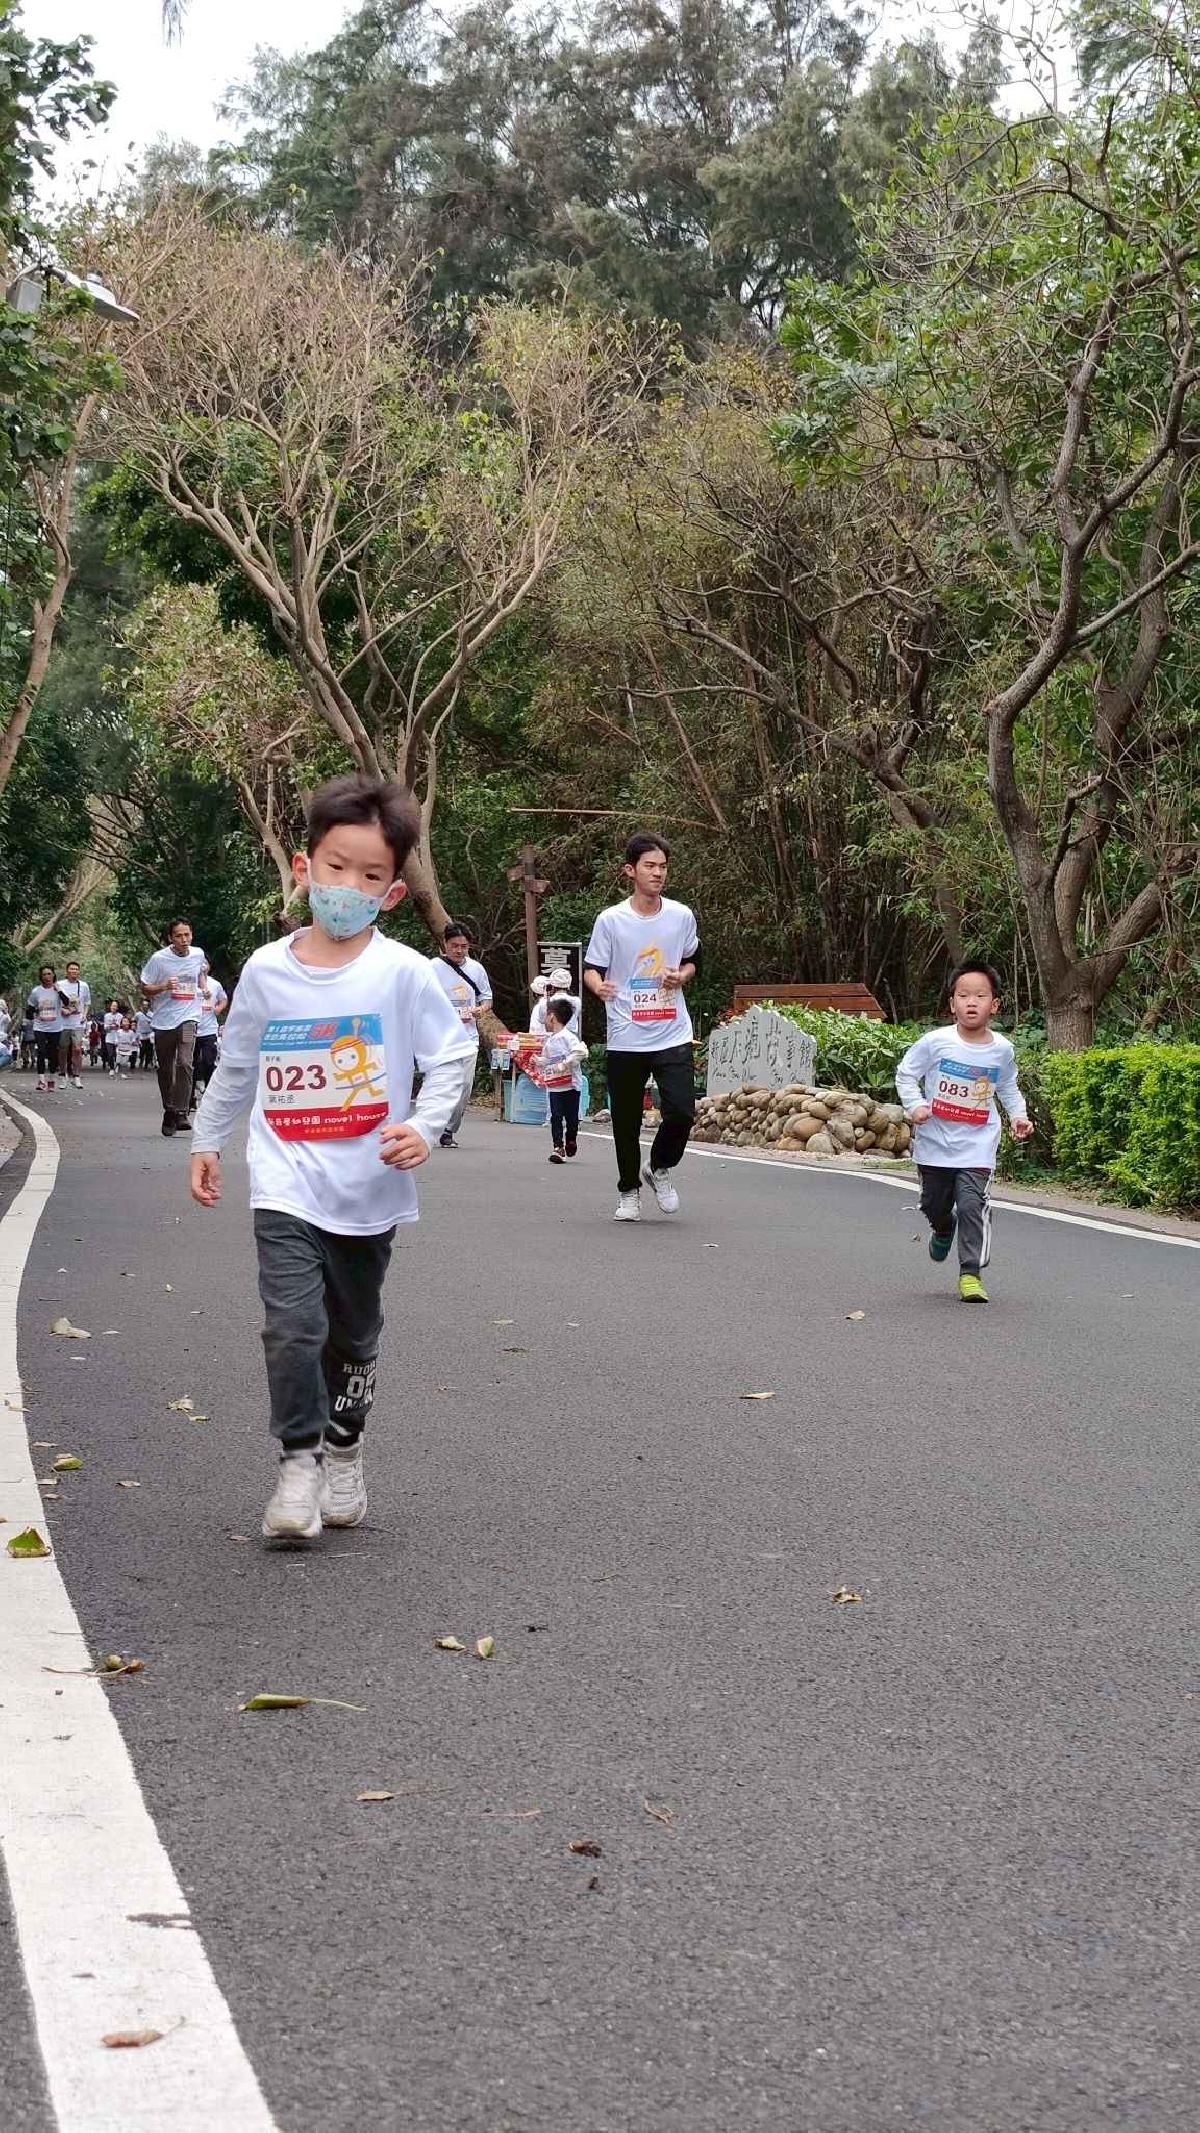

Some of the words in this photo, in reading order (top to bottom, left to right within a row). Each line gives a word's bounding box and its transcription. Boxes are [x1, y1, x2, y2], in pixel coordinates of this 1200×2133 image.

[634, 993, 657, 1003] 024
[265, 1064, 327, 1092] 023
[939, 1080, 969, 1098] 083
